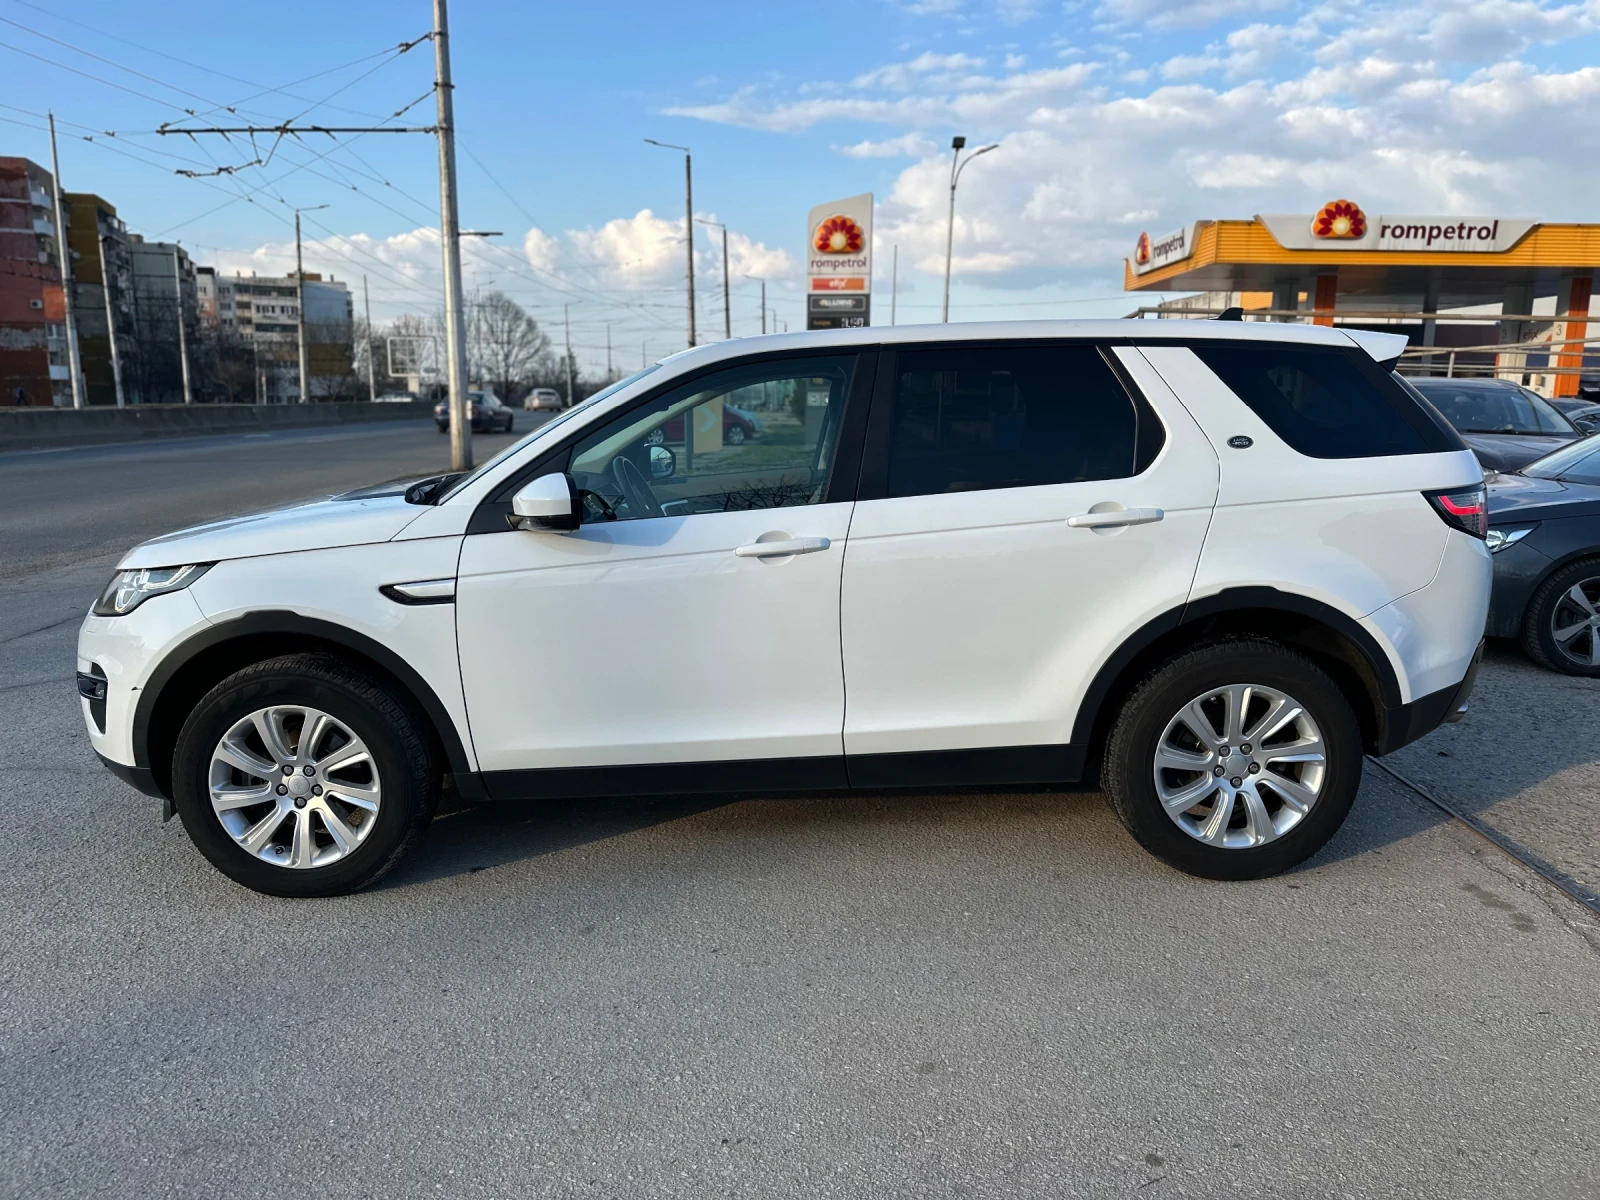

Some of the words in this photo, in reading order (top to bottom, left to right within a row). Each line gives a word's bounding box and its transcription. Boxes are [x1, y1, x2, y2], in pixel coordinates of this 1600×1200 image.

[1380, 219, 1499, 246] rompetrol
[1153, 227, 1185, 260] rompetrol
[810, 257, 866, 270] rompetrol
[1523, 328, 1540, 342] efix
[1556, 324, 1562, 336] 3
